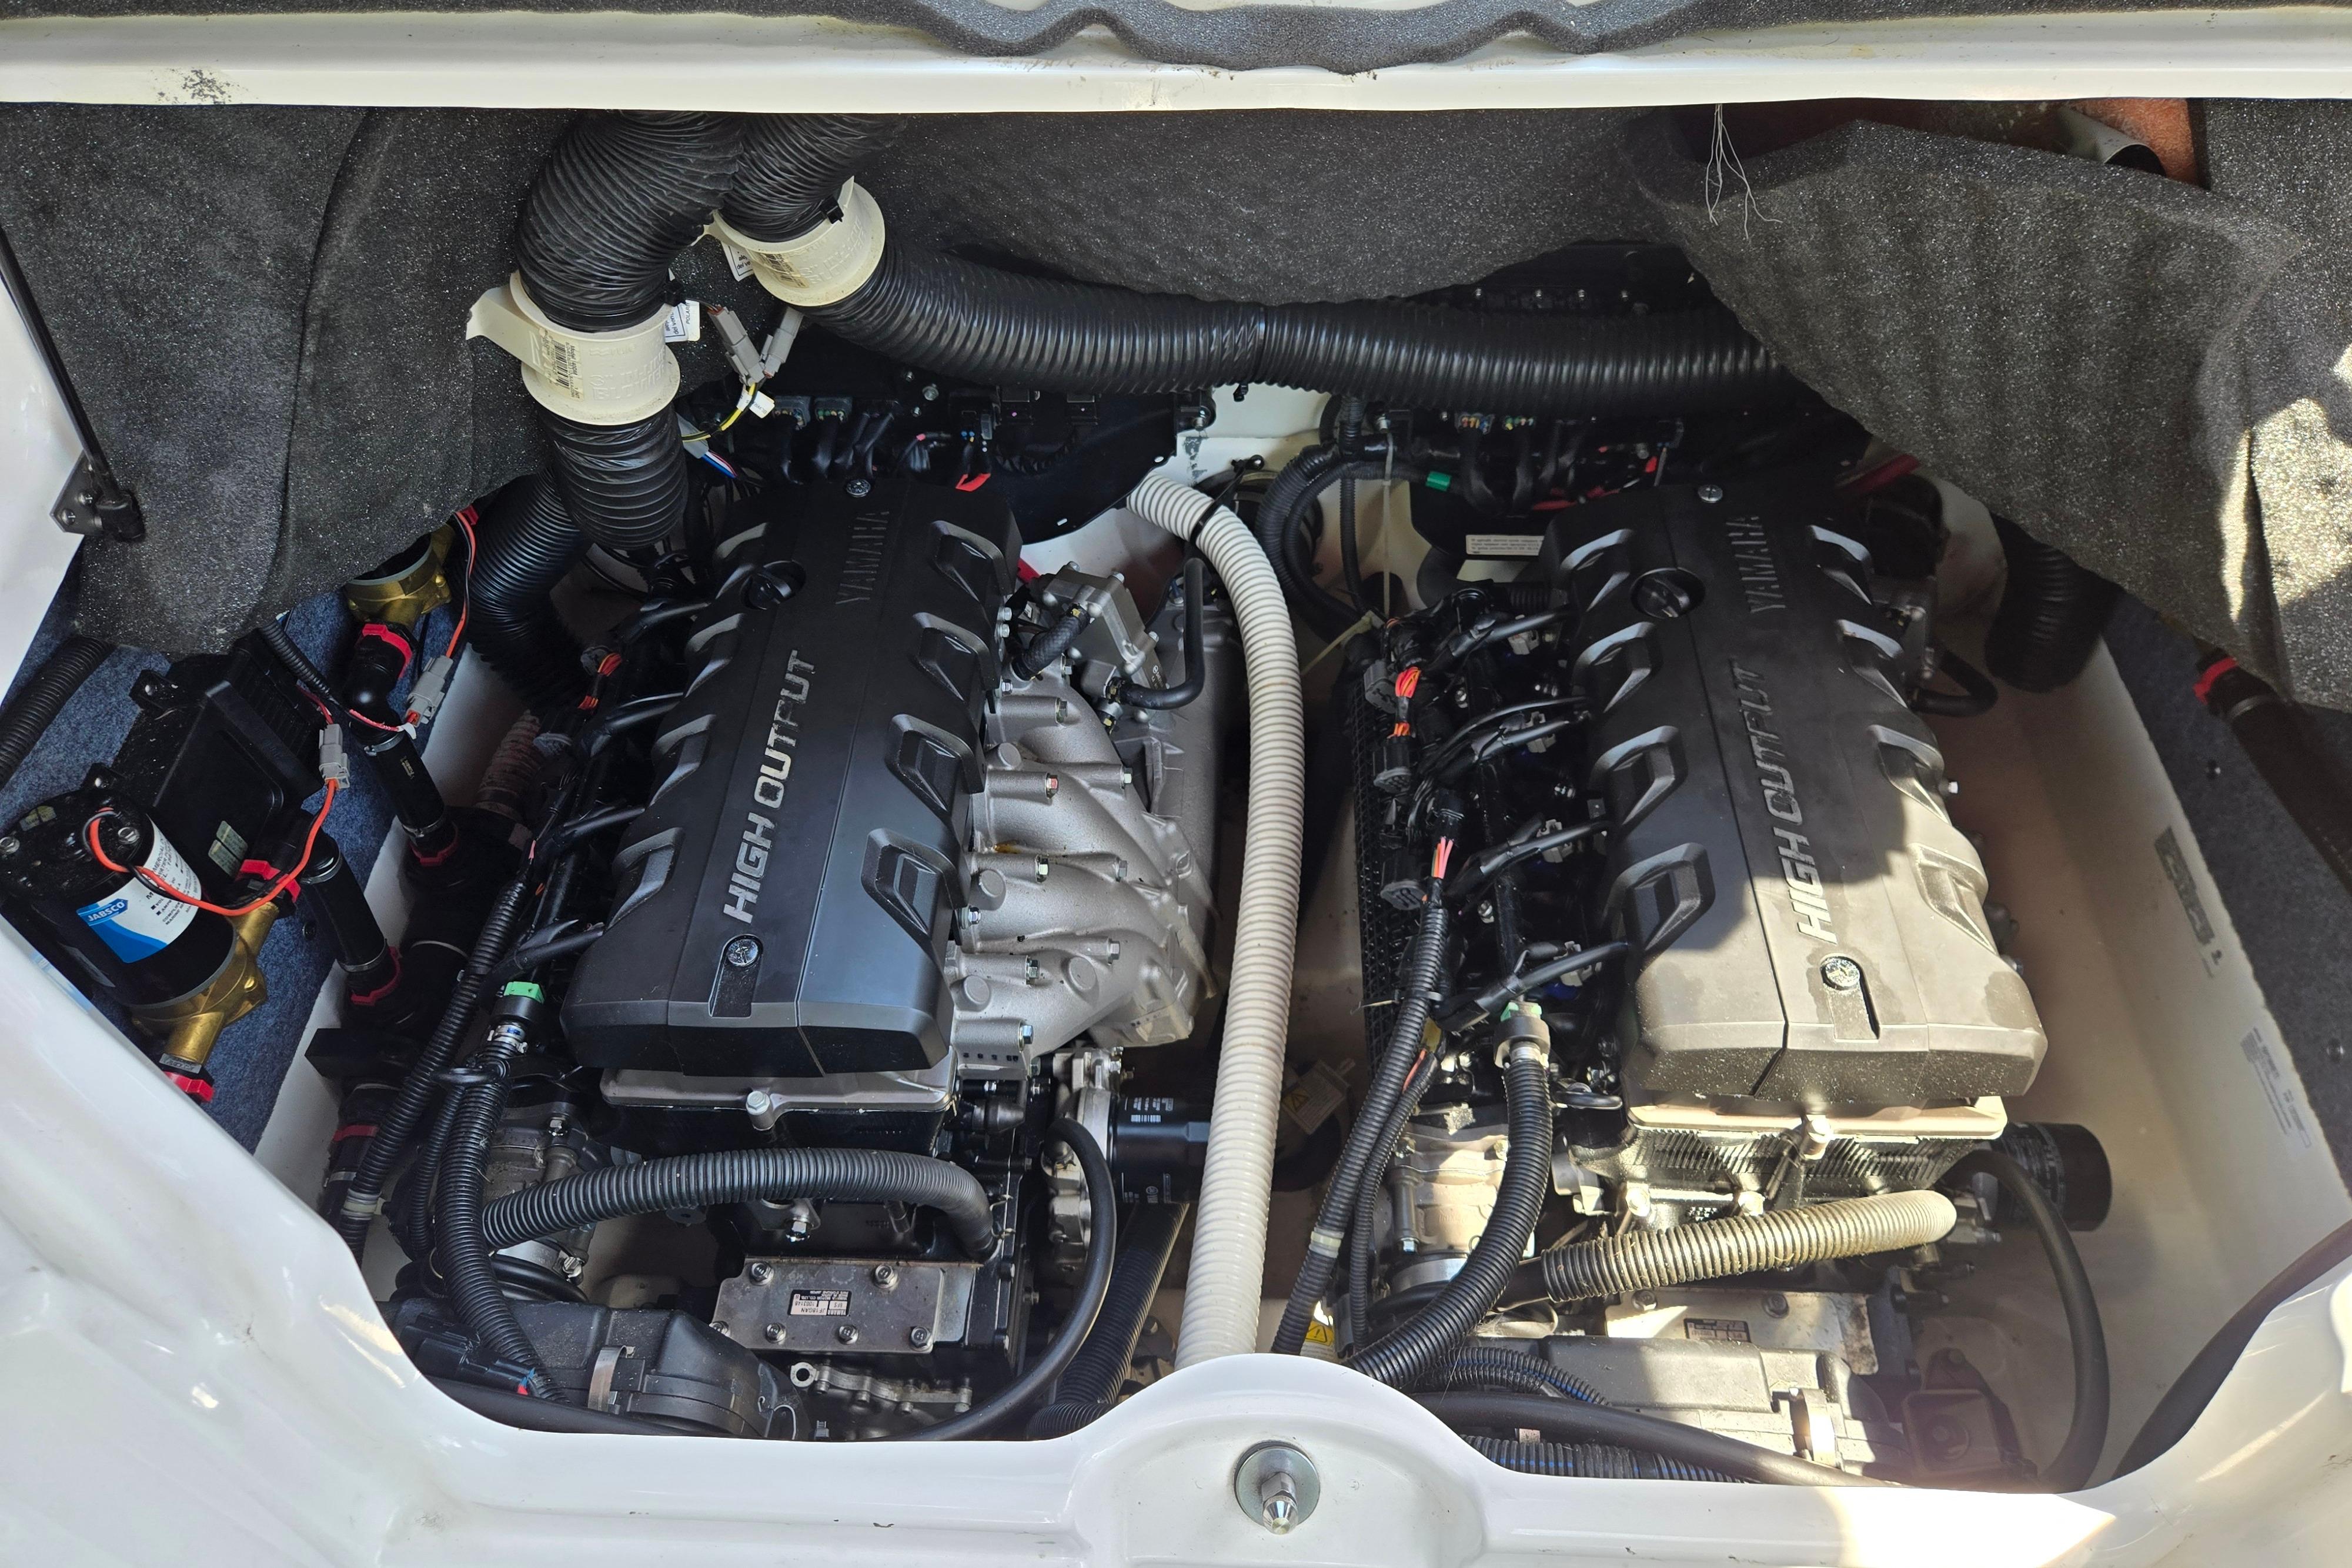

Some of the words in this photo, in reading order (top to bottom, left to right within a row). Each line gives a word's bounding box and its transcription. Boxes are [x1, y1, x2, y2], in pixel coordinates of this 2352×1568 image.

[836, 510, 890, 605] YAMAHA
[1726, 515, 1786, 613] YAMAHA
[723, 811, 776, 924] HIGH
[753, 649, 817, 810] OUTPUT
[1729, 658, 1802, 825] OUTPUT
[88, 901, 125, 922] JABSCO
[1773, 825, 1838, 945] HIGH
